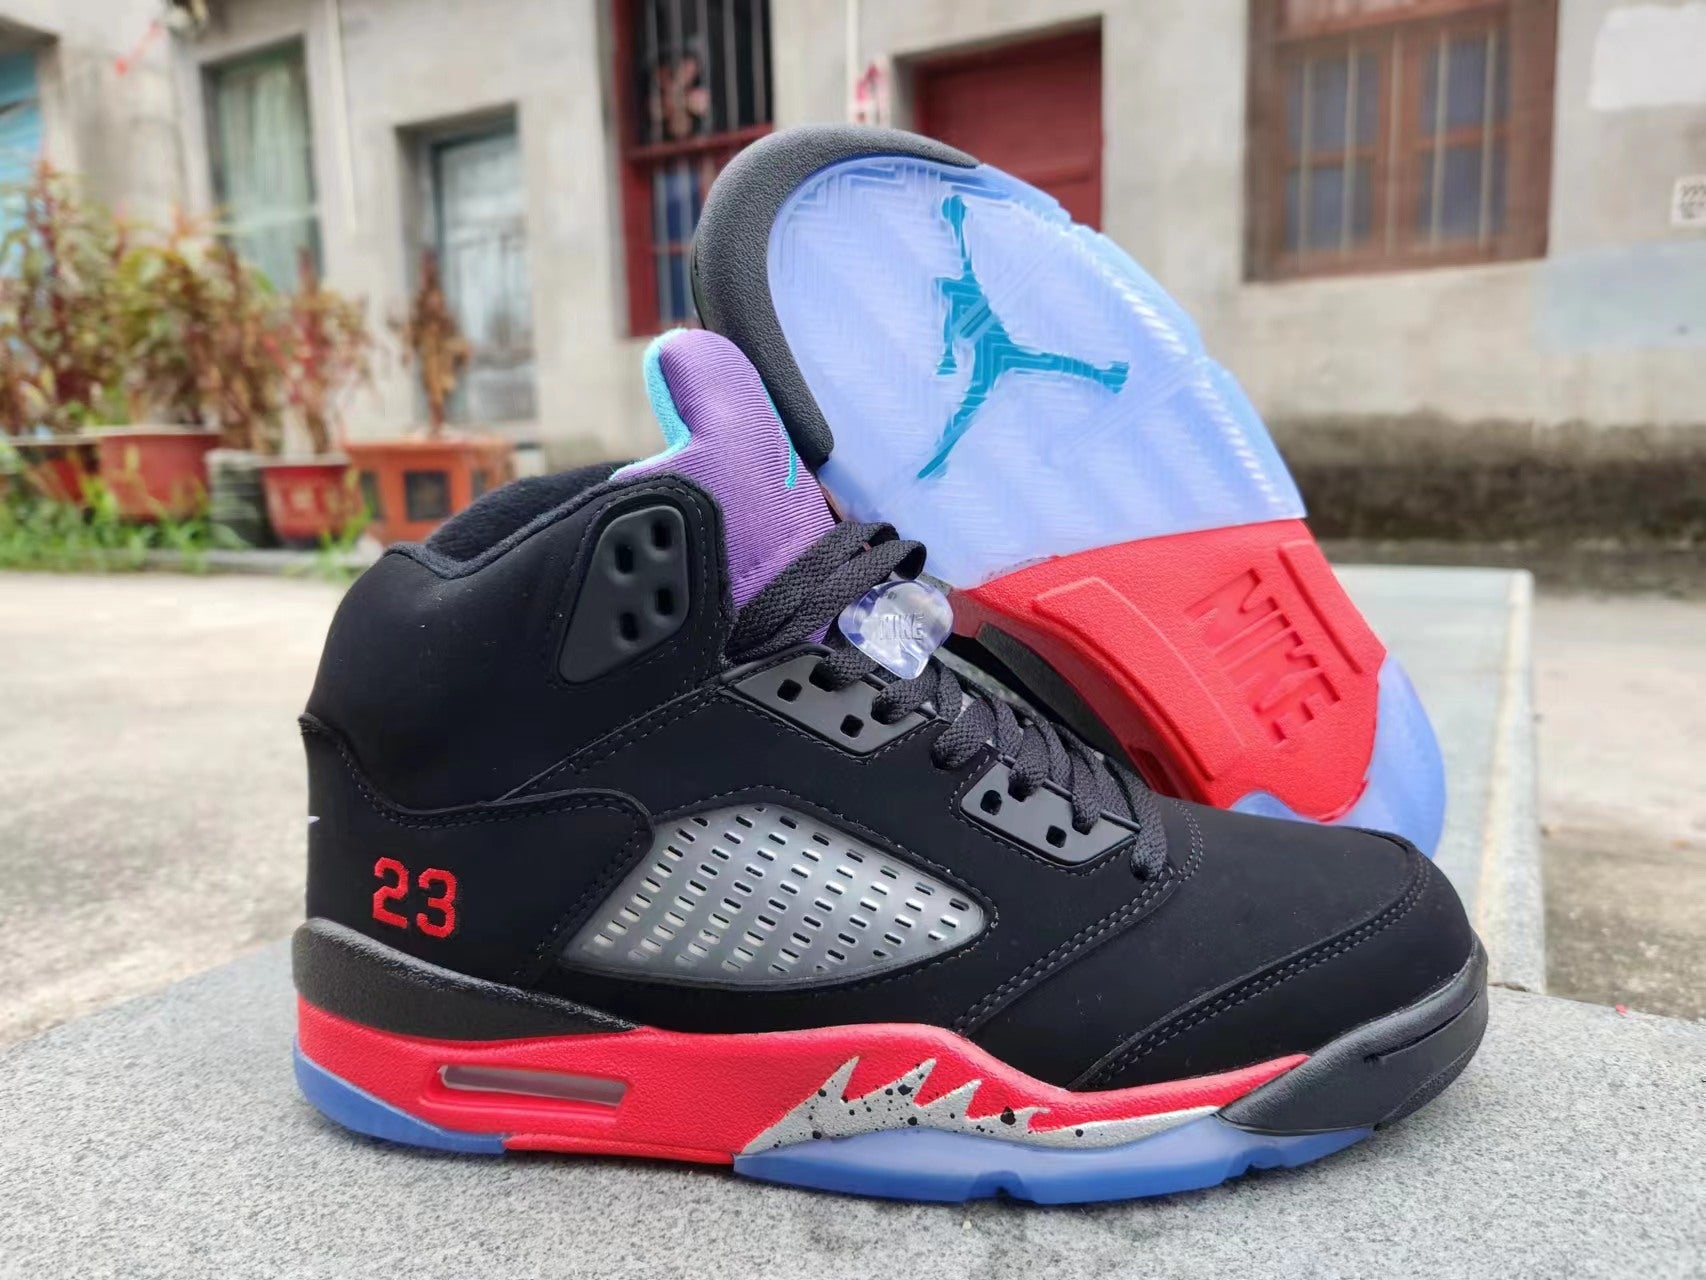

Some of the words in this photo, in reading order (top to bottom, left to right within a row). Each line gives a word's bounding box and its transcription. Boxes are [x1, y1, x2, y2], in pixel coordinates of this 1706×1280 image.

[880, 612, 925, 641] NIKE
[1184, 568, 1341, 748] NIKE
[372, 856, 458, 938] 23
